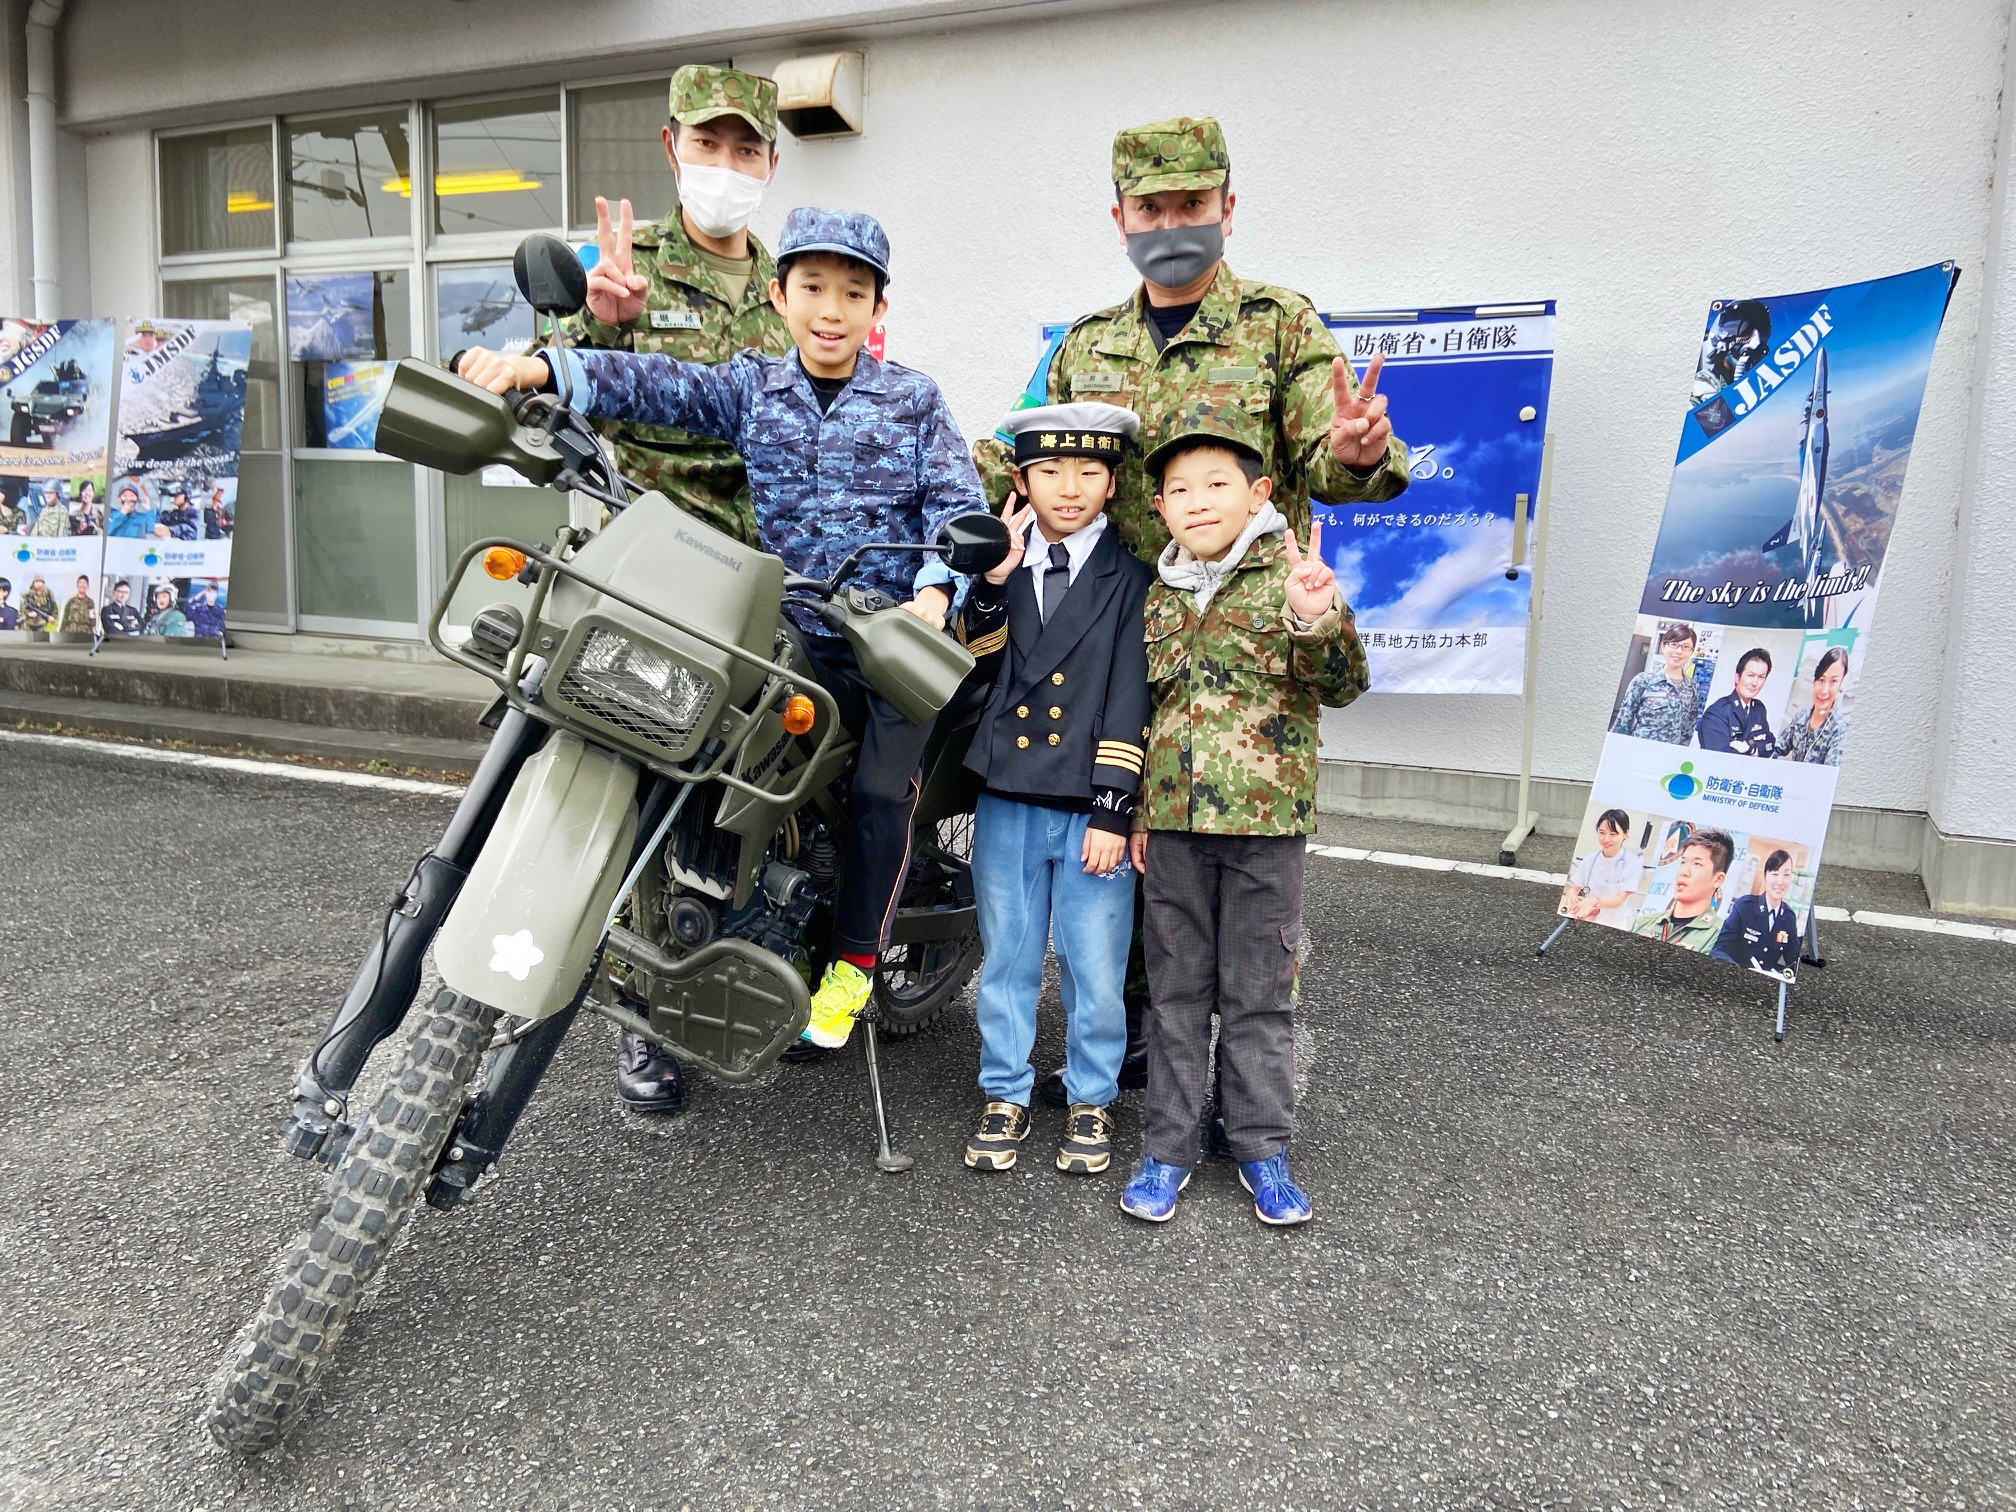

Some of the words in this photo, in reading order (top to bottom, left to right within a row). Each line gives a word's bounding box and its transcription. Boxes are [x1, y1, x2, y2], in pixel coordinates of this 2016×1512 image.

[11, 323, 61, 375] JGSDF
[145, 324, 196, 376] JMSDF
[1353, 324, 1518, 357] 防衛省・自衛隊
[1733, 303, 1834, 416] JASDF
[119, 458, 145, 469] How
[146, 458, 173, 469] deep
[175, 457, 184, 468] is
[186, 457, 203, 468] the
[674, 528, 742, 572] Kawasaki
[1661, 579, 1706, 602] The
[1706, 581, 1748, 607] sky
[1749, 580, 1770, 603] is
[1773, 578, 1808, 601] the
[1809, 565, 1872, 599] limit!!
[1358, 632, 1488, 649] 群馬地方協力本部
[1702, 794, 1737, 806] MINISTRY
[1748, 802, 1780, 813] DEFENSE
[1705, 776, 1783, 800] 防衛省・自衛隊
